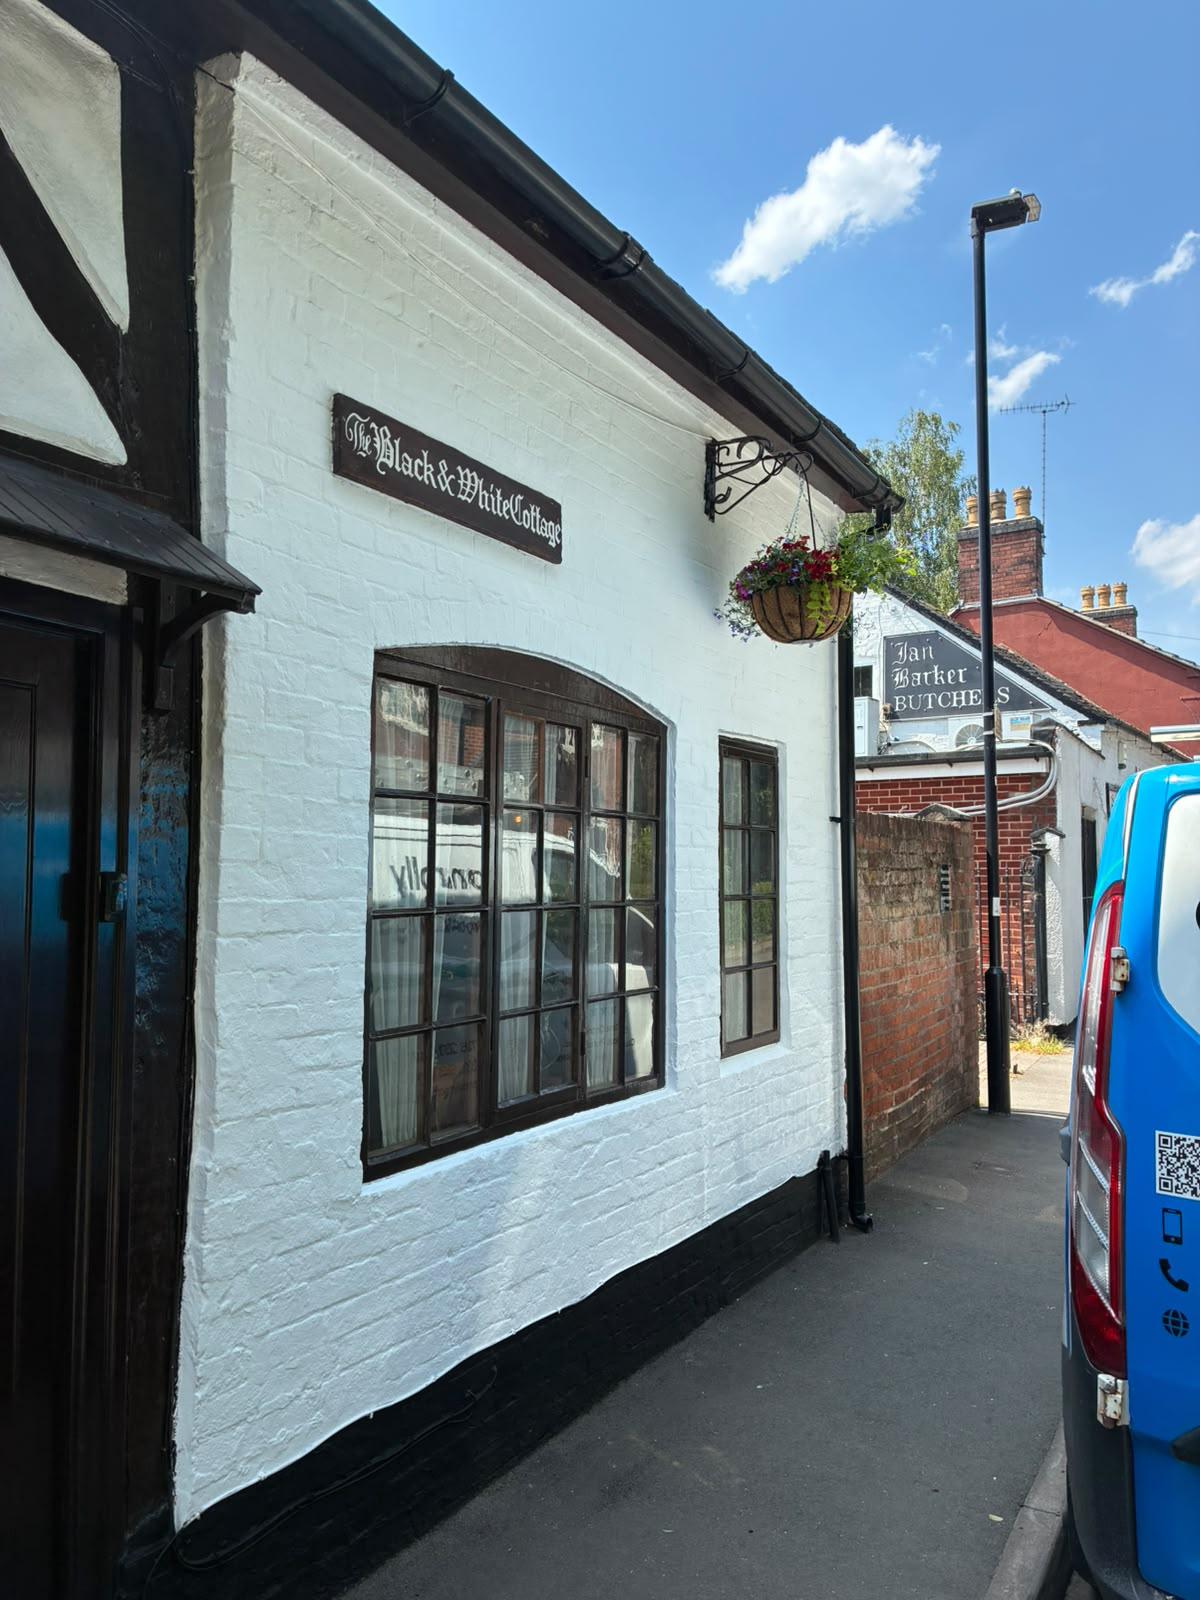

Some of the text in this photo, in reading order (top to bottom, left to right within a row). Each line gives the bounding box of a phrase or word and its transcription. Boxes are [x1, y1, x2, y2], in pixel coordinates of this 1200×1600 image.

[345, 412, 561, 548] The Black & White Cottage
[892, 664, 967, 690] Barker
[894, 686, 1010, 712] BUTCHES
